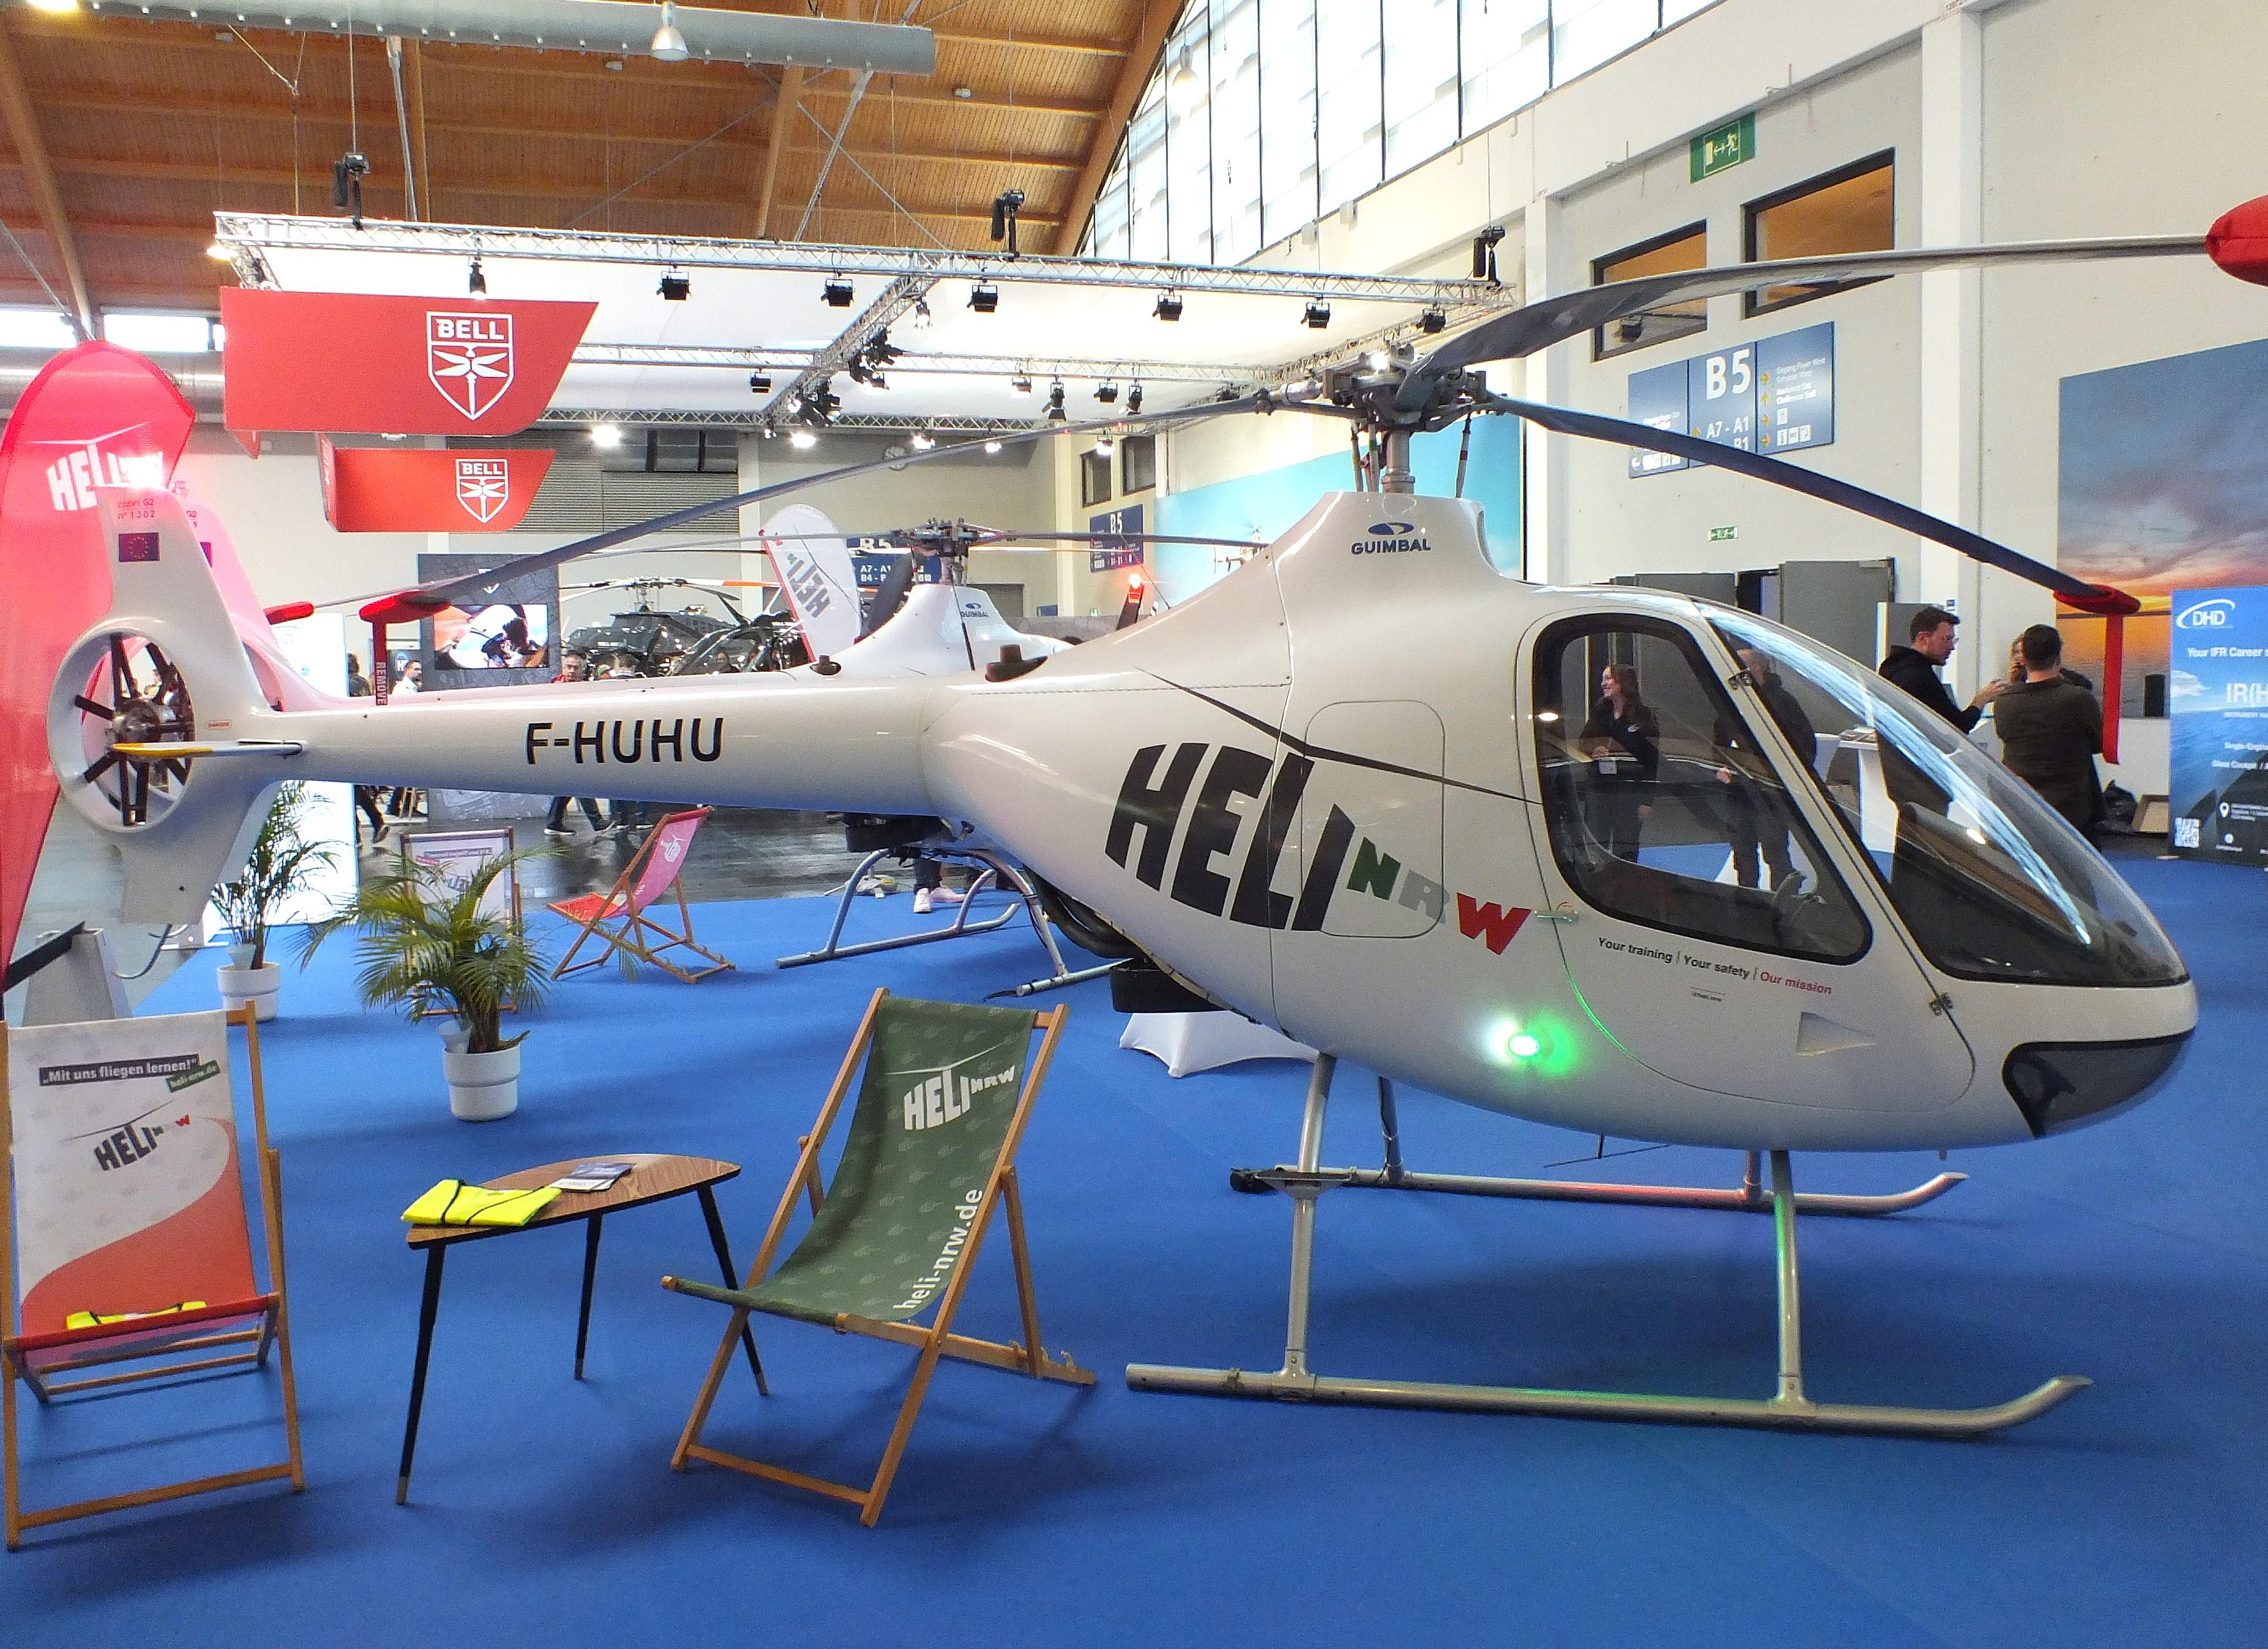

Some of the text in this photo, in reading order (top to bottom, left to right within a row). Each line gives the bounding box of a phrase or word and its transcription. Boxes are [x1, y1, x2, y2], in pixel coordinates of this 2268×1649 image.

[436, 319, 505, 340] BELL
[1706, 349, 1751, 401] B5
[1706, 421, 1722, 439] A7
[1733, 416, 1749, 433] A1
[461, 463, 503, 475] BELL
[1110, 512, 1123, 534] B5
[1351, 538, 1431, 555] GUIMBAL
[2193, 610, 2225, 625] DHD
[2187, 647, 2209, 657] Your
[2211, 647, 2228, 657] IFR
[2229, 647, 2263, 657] Career
[376, 661, 387, 705] REMOVE
[527, 718, 724, 764] F-HUHU
[1105, 742, 1531, 955] HELI NRW
[1598, 937, 1624, 951] Your
[1628, 945, 1672, 963] training
[1683, 956, 1711, 970] Your
[1714, 963, 1750, 980] safety
[1760, 971, 1782, 984] Our
[1785, 977, 1832, 994] mission
[74, 1070, 96, 1079] uns
[100, 1064, 144, 1079] fliegen
[903, 1065, 1015, 1131] HELI NRW
[94, 1124, 158, 1171] HELI
[893, 1189, 983, 1310] heli-nrw.de
